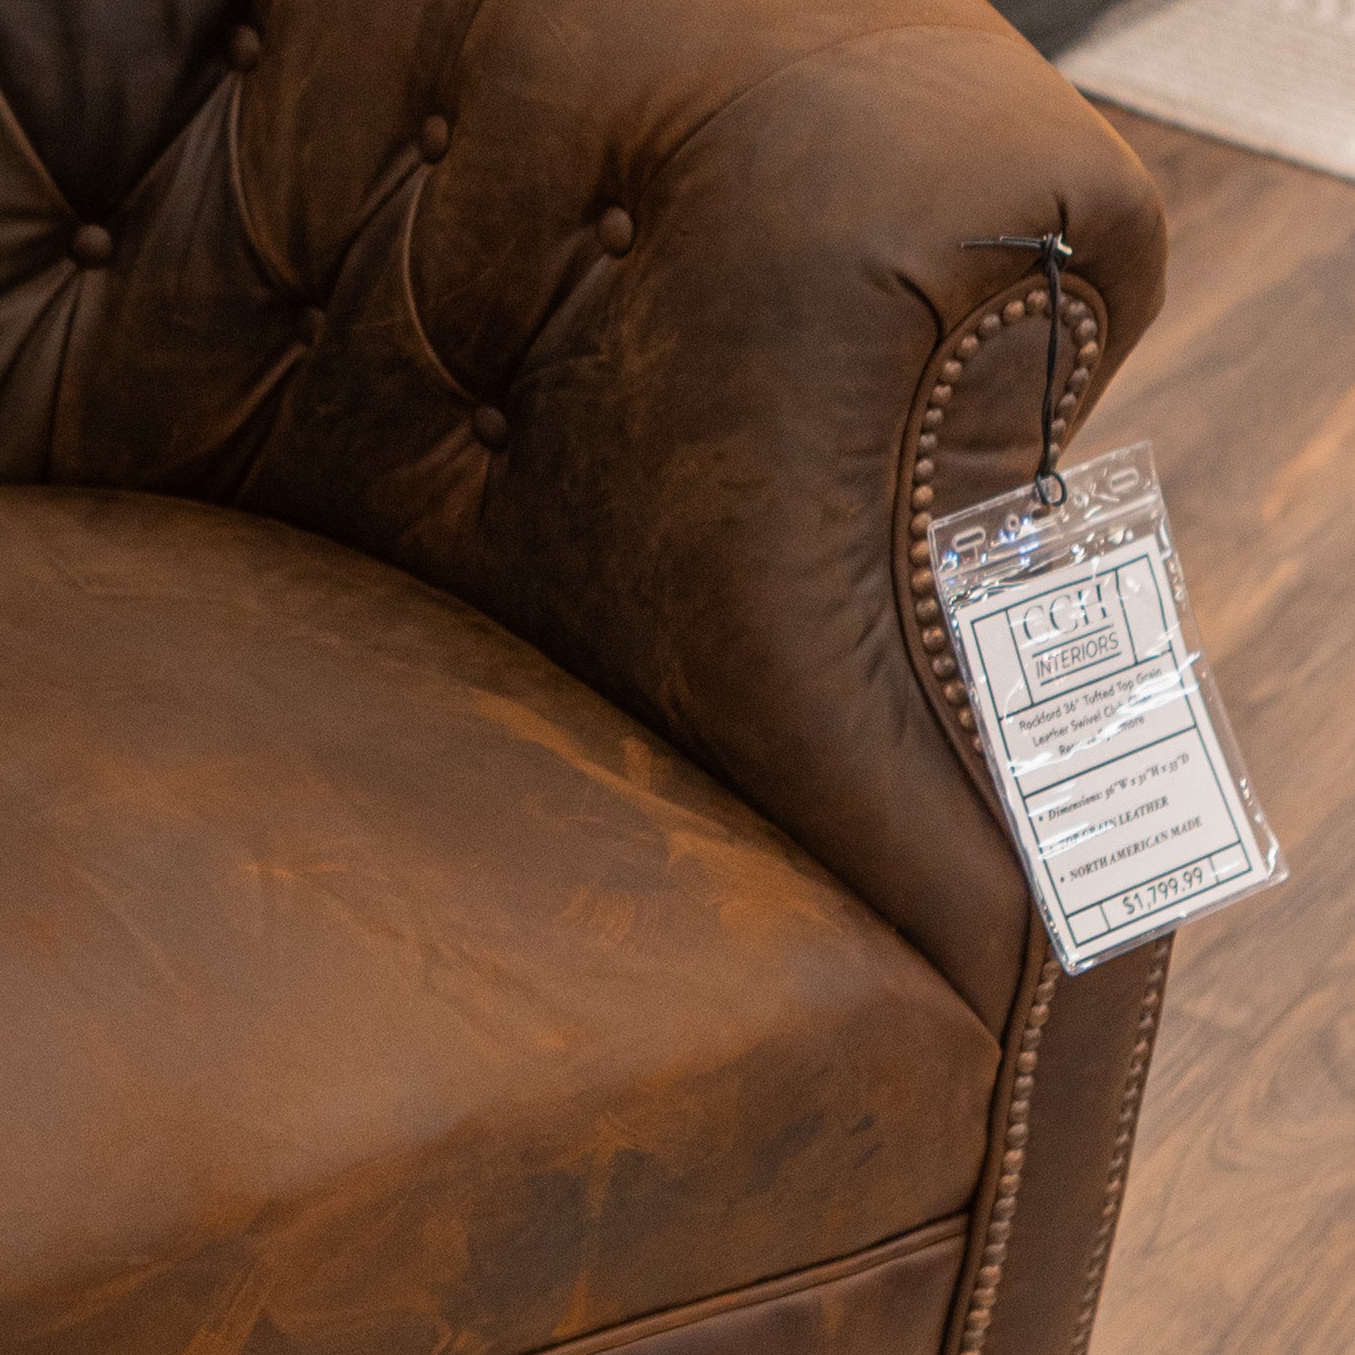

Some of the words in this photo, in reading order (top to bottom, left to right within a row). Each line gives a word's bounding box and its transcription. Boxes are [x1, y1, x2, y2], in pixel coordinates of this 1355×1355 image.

[1023, 584, 1109, 644] CCH
[1035, 631, 1119, 679] INTERIORS
[1019, 710, 1062, 731] Rockford
[1064, 698, 1079, 714] 36"
[1083, 685, 1115, 706] Tufted
[1117, 679, 1134, 693] Top
[1136, 668, 1163, 684] Grain
[1033, 726, 1069, 748] Leather
[1071, 710, 1102, 732] Swivel
[1048, 791, 1102, 821] Dimensions:
[1119, 795, 1170, 826] LEATHER
[1069, 856, 1108, 882] NORTH
[1109, 830, 1168, 866] AMERICAN
[1169, 815, 1203, 839] MADE
[1122, 866, 1204, 915] $1,799.99
